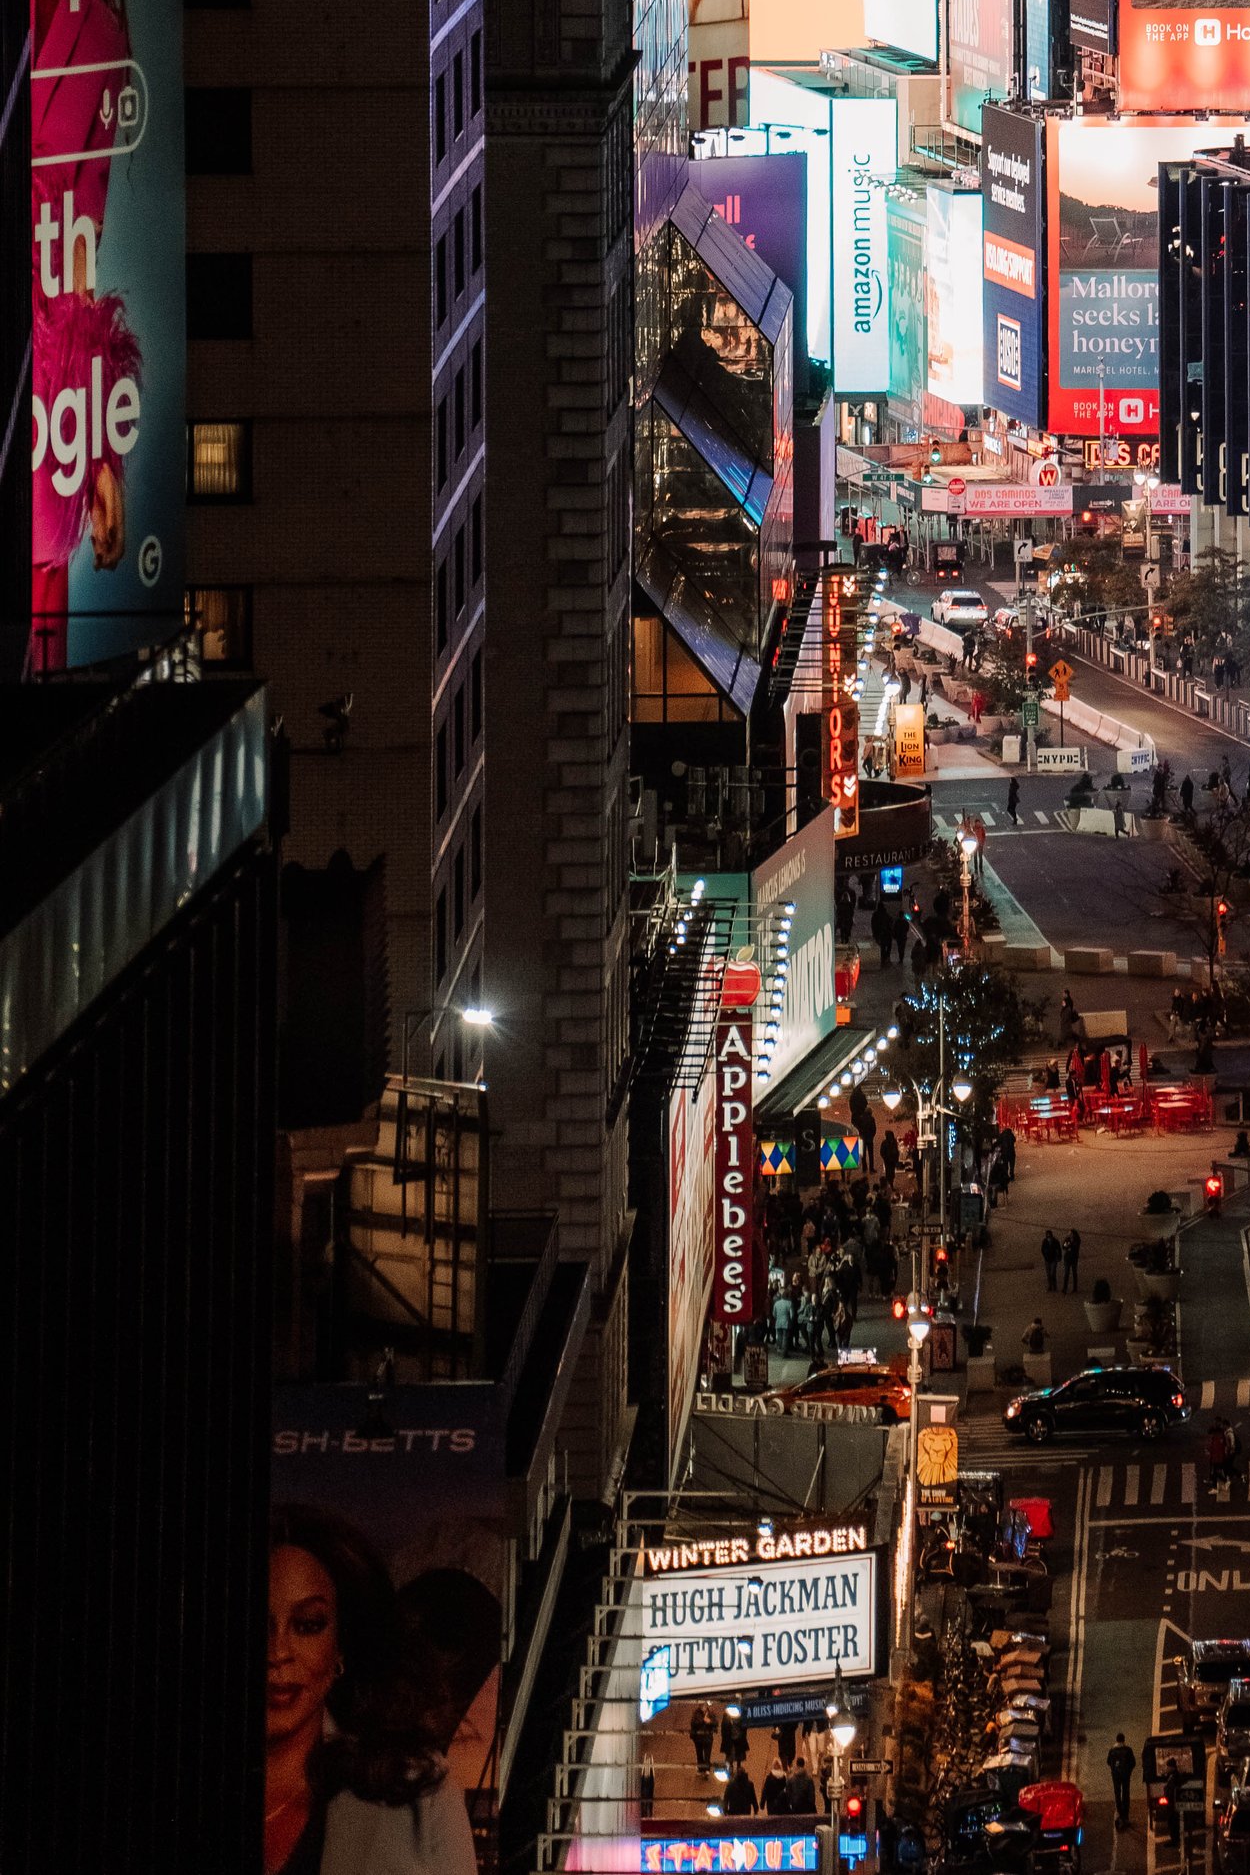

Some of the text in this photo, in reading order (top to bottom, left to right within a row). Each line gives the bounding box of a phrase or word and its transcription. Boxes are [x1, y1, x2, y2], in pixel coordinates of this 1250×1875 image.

[1145, 23, 1189, 33] BOOK ON
[1145, 32, 1189, 41] THE APP
[848, 154, 871, 333] amazon music
[1072, 302, 1141, 326] seeks
[1001, 327, 1017, 377] USO
[1119, 365, 1151, 376] HOTEL,
[1073, 402, 1098, 411] BOOK
[1073, 410, 1115, 419] THE APP
[974, 489, 991, 499] DOS
[996, 489, 1037, 499] CAMINOS
[969, 499, 1042, 509] WE ARE OPEN
[903, 731, 916, 739] THE
[900, 741, 919, 754] LION
[898, 754, 922, 767] KING
[1042, 755, 1073, 764] NYPD
[717, 1025, 750, 1315] Applebee's
[648, 1525, 868, 1571] WINTER GARDEN
[649, 1573, 860, 1629] HUGH JACKMAN
[649, 1624, 860, 1679] UTTON FOSTER
